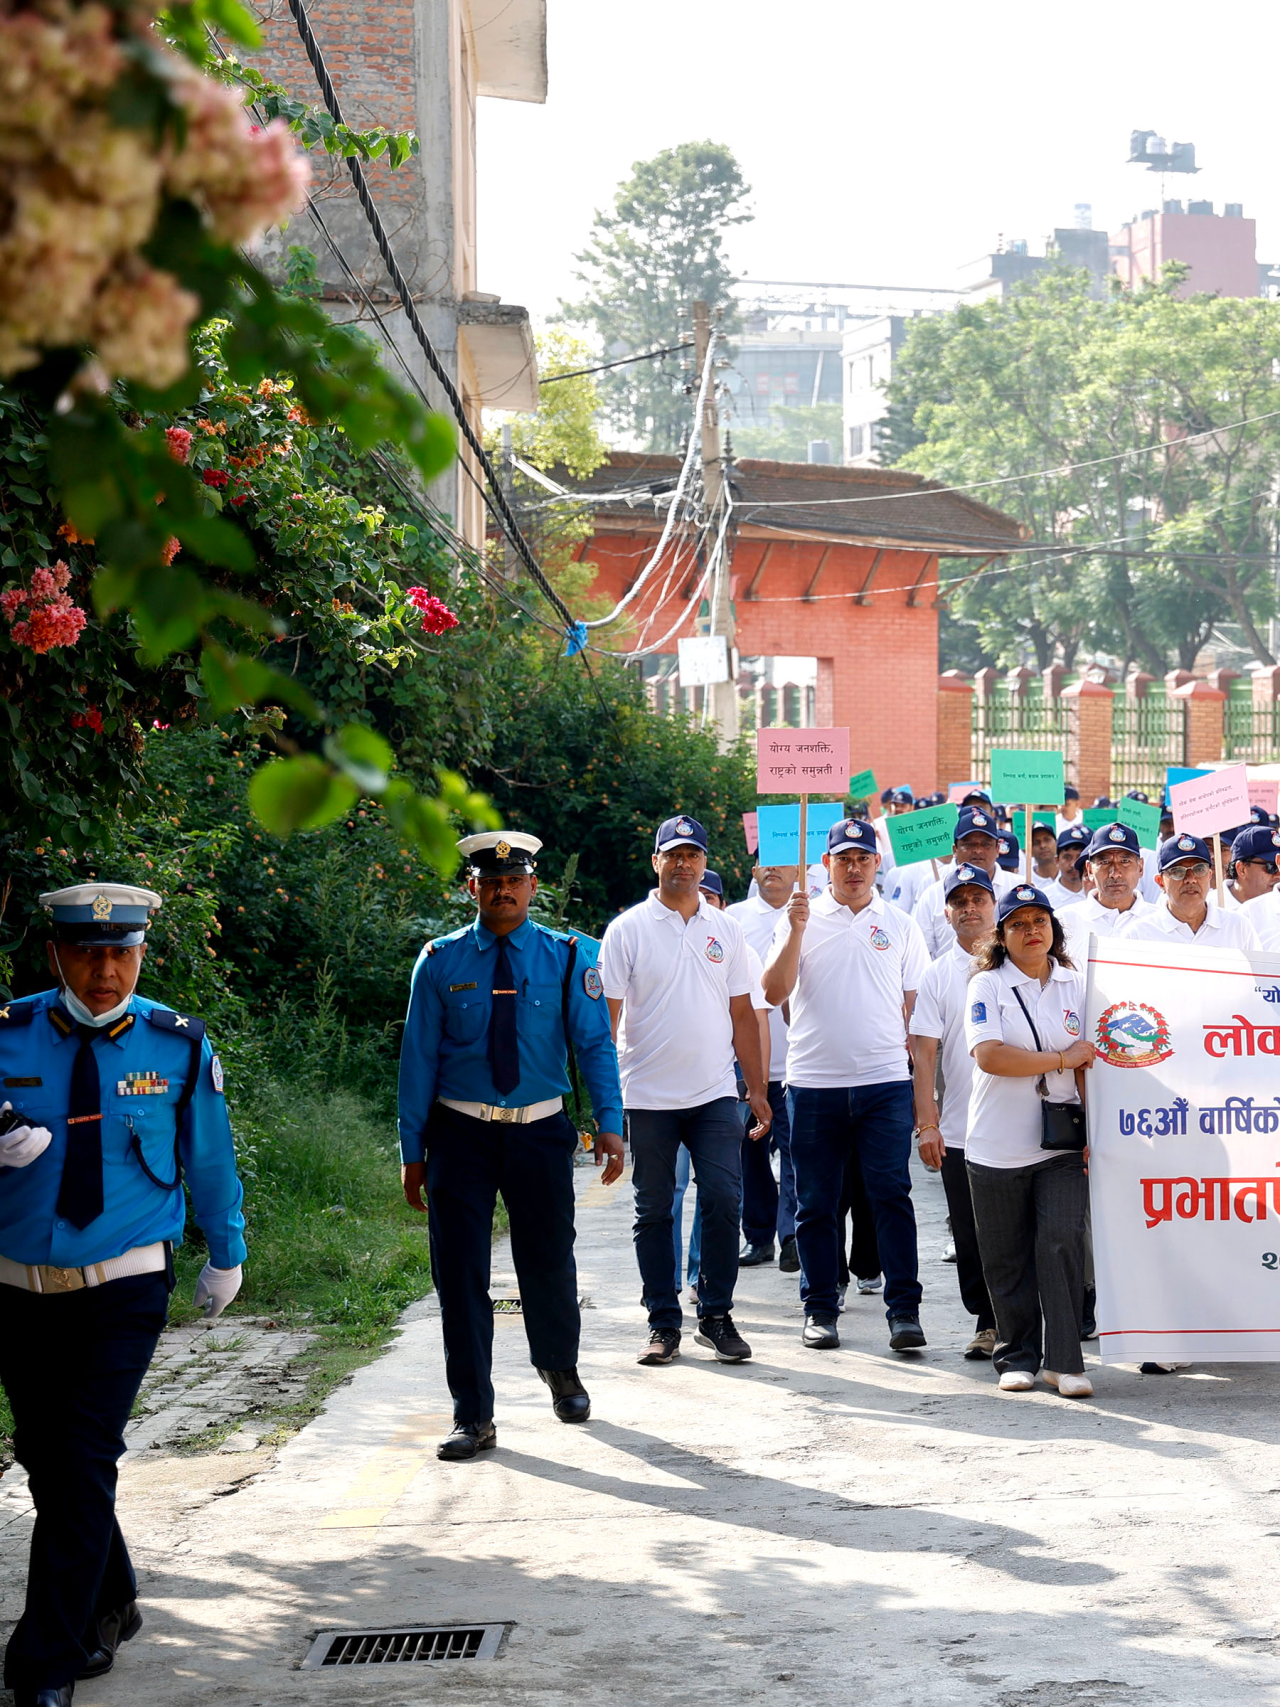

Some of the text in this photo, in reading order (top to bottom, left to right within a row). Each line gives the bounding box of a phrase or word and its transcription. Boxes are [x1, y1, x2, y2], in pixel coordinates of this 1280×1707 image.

[769, 742, 791, 753] योग्य
[769, 764, 797, 778] राष्ट्रको
[801, 764, 832, 778] समुन्नती
[896, 825, 914, 835] योग्य
